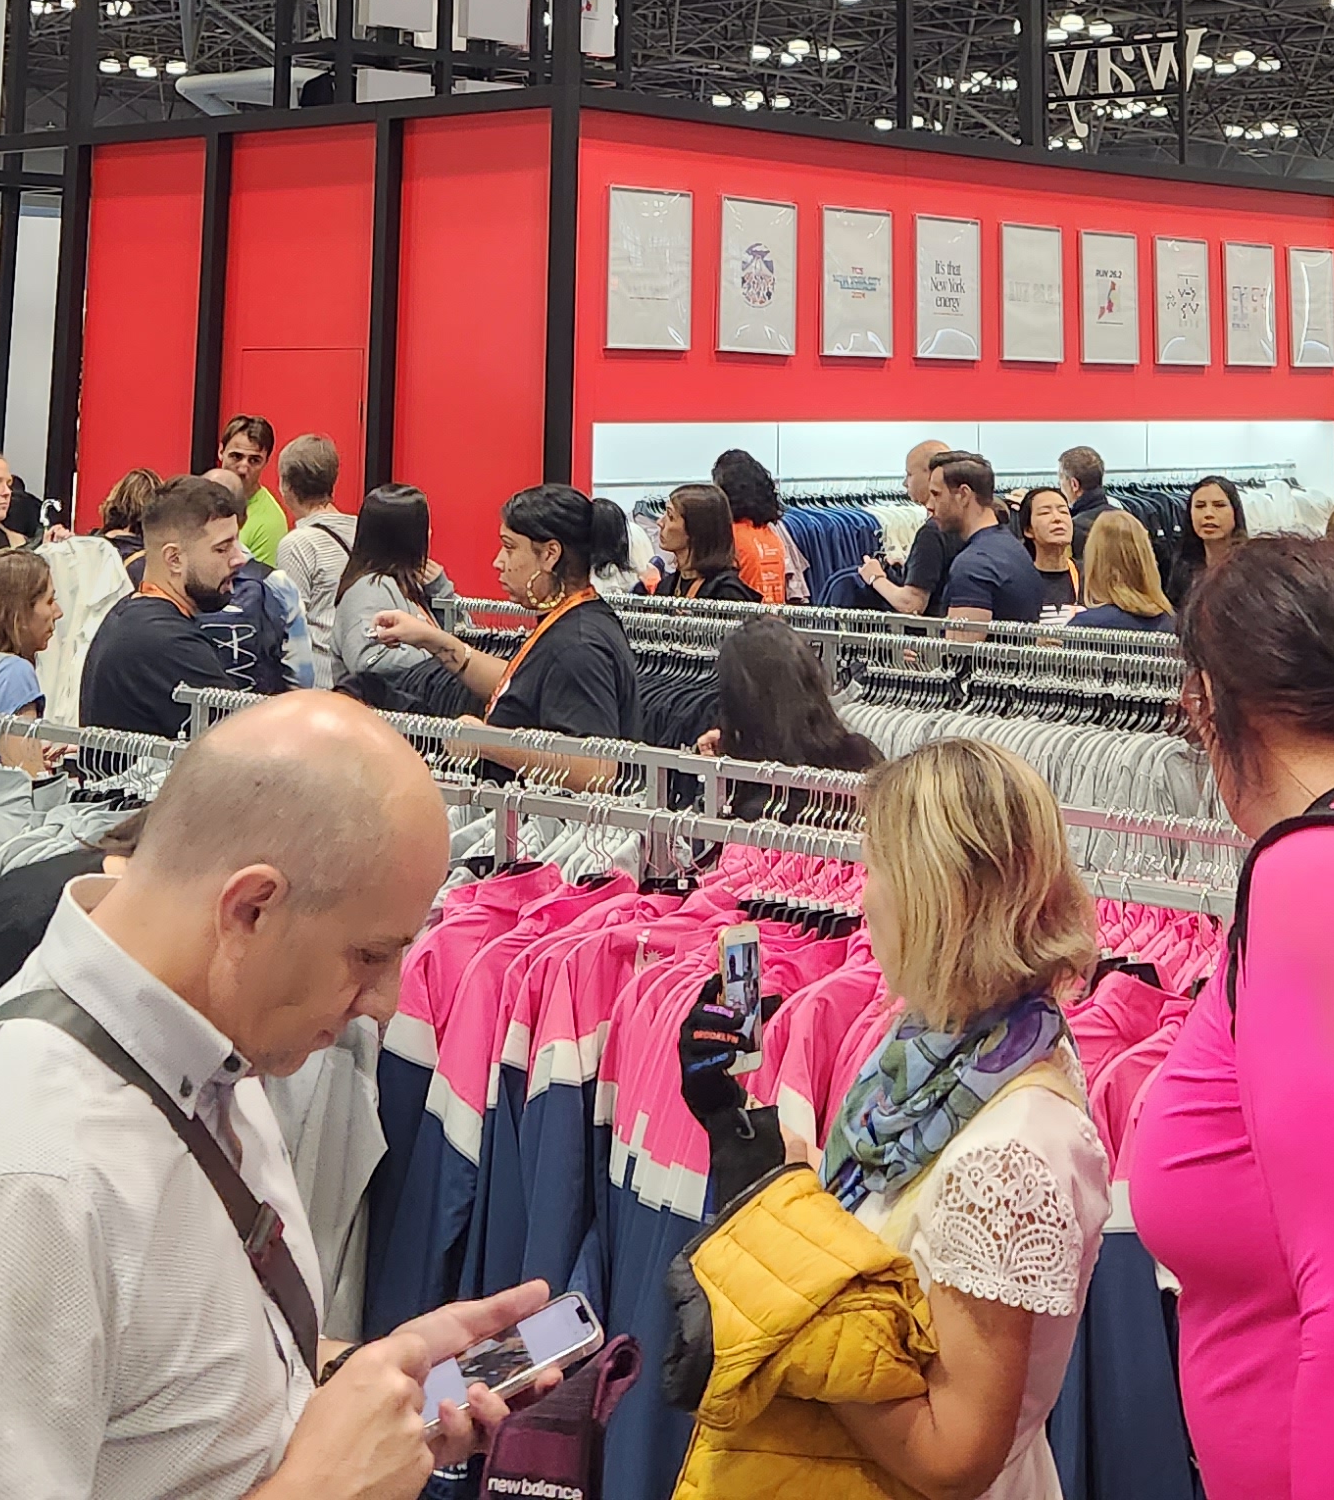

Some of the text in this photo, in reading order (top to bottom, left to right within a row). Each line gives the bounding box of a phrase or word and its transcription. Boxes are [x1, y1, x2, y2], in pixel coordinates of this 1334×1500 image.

[947, 260, 961, 276] that
[1095, 269, 1109, 278] RUN
[931, 276, 966, 294] New York
[935, 296, 961, 313] energy
[487, 1476, 584, 1500] new balance
